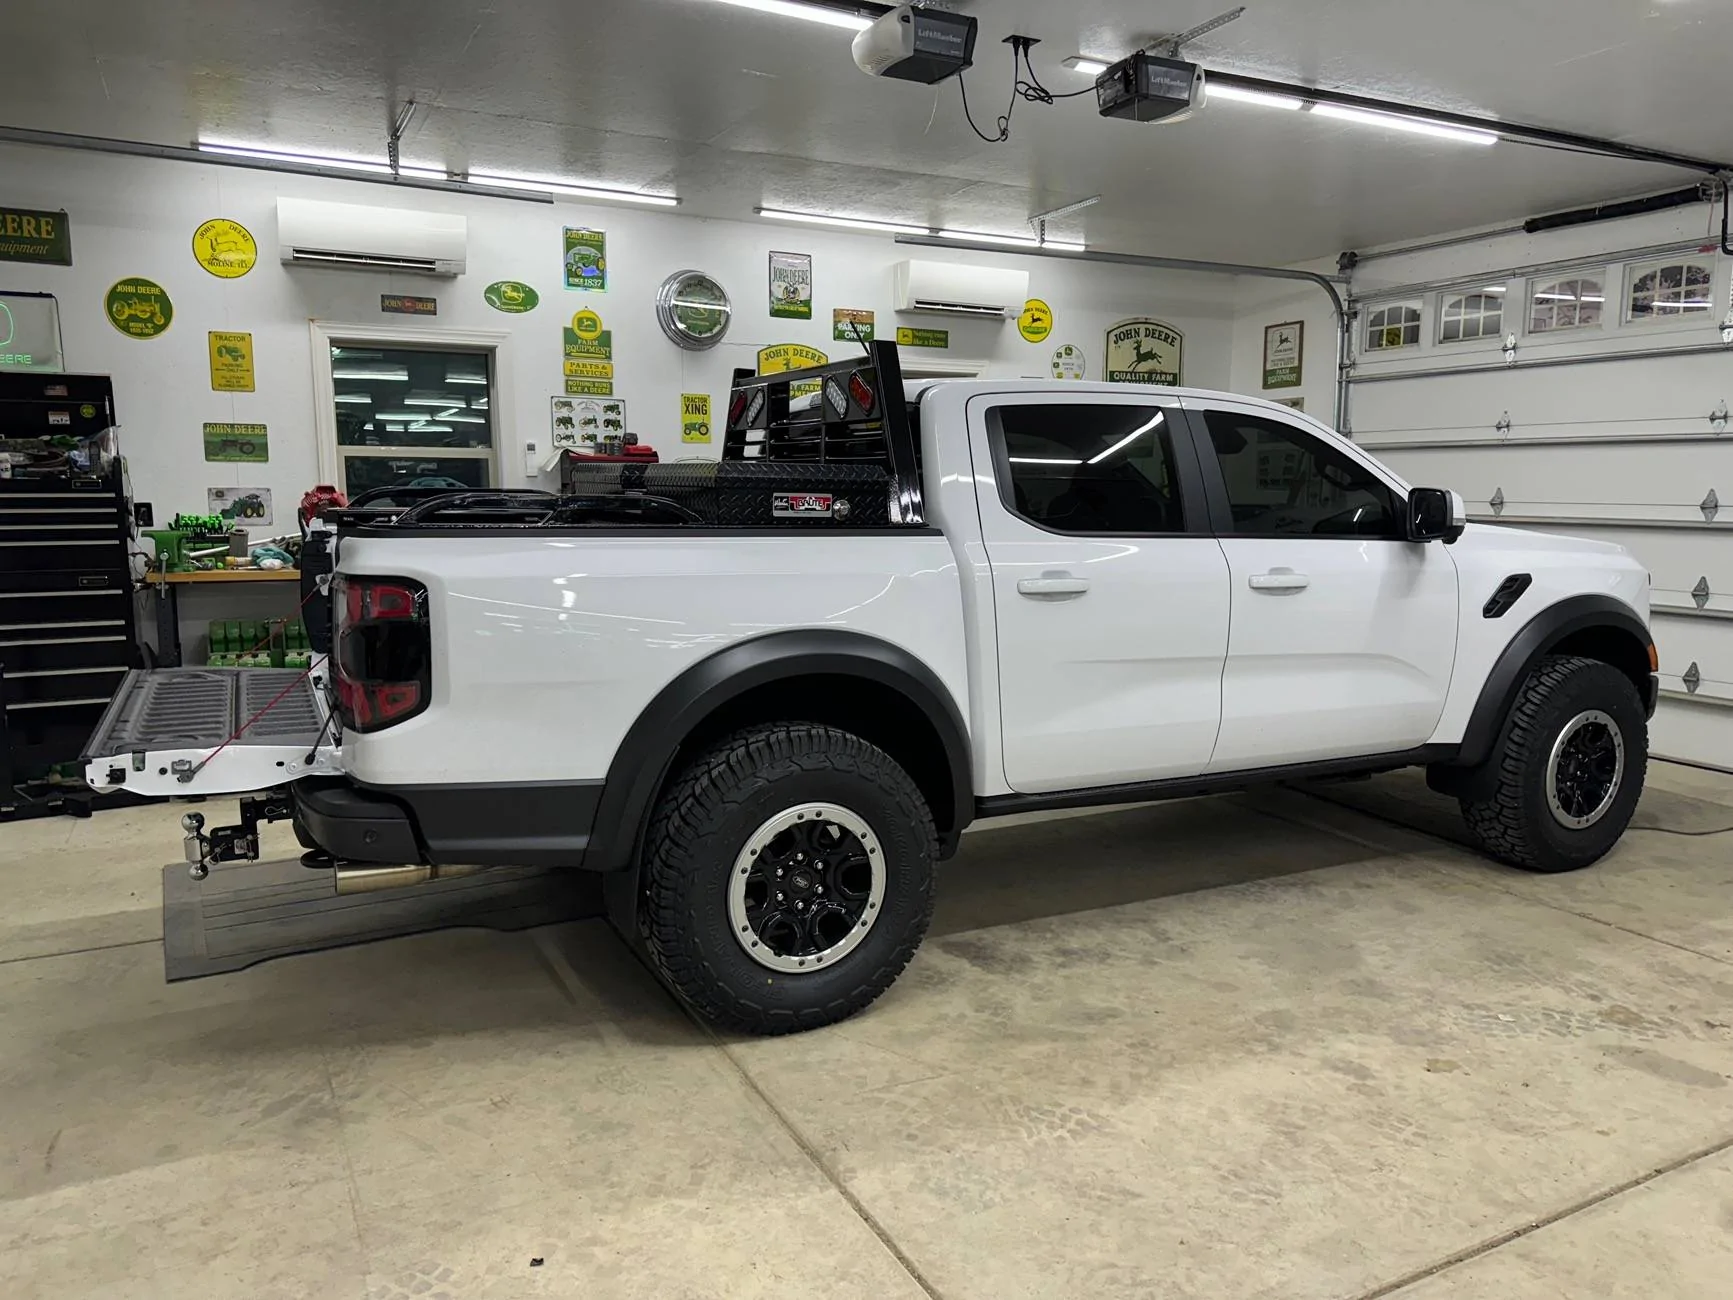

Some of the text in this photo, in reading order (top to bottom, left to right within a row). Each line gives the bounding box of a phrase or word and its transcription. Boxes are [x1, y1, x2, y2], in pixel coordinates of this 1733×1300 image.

[0, 241, 48, 255] uipment
[584, 278, 603, 287] 1837
[116, 285, 161, 295] JOHN DEERE
[214, 335, 246, 343] TRACTOR
[577, 338, 599, 346] FARM
[1113, 327, 1177, 347] JOHN DEERE
[565, 343, 611, 356] EQUIPMENT
[764, 347, 823, 364] JOHN DEERE
[570, 361, 599, 370] PARTS
[569, 368, 609, 377] SERVICES
[1113, 372, 1174, 382] QUALITY FARM
[567, 385, 583, 393] LIKE
[590, 386, 610, 394] DEERE
[683, 395, 708, 404] TRACTOR
[684, 403, 708, 415] XING
[205, 423, 267, 435] JOHN DEERE
